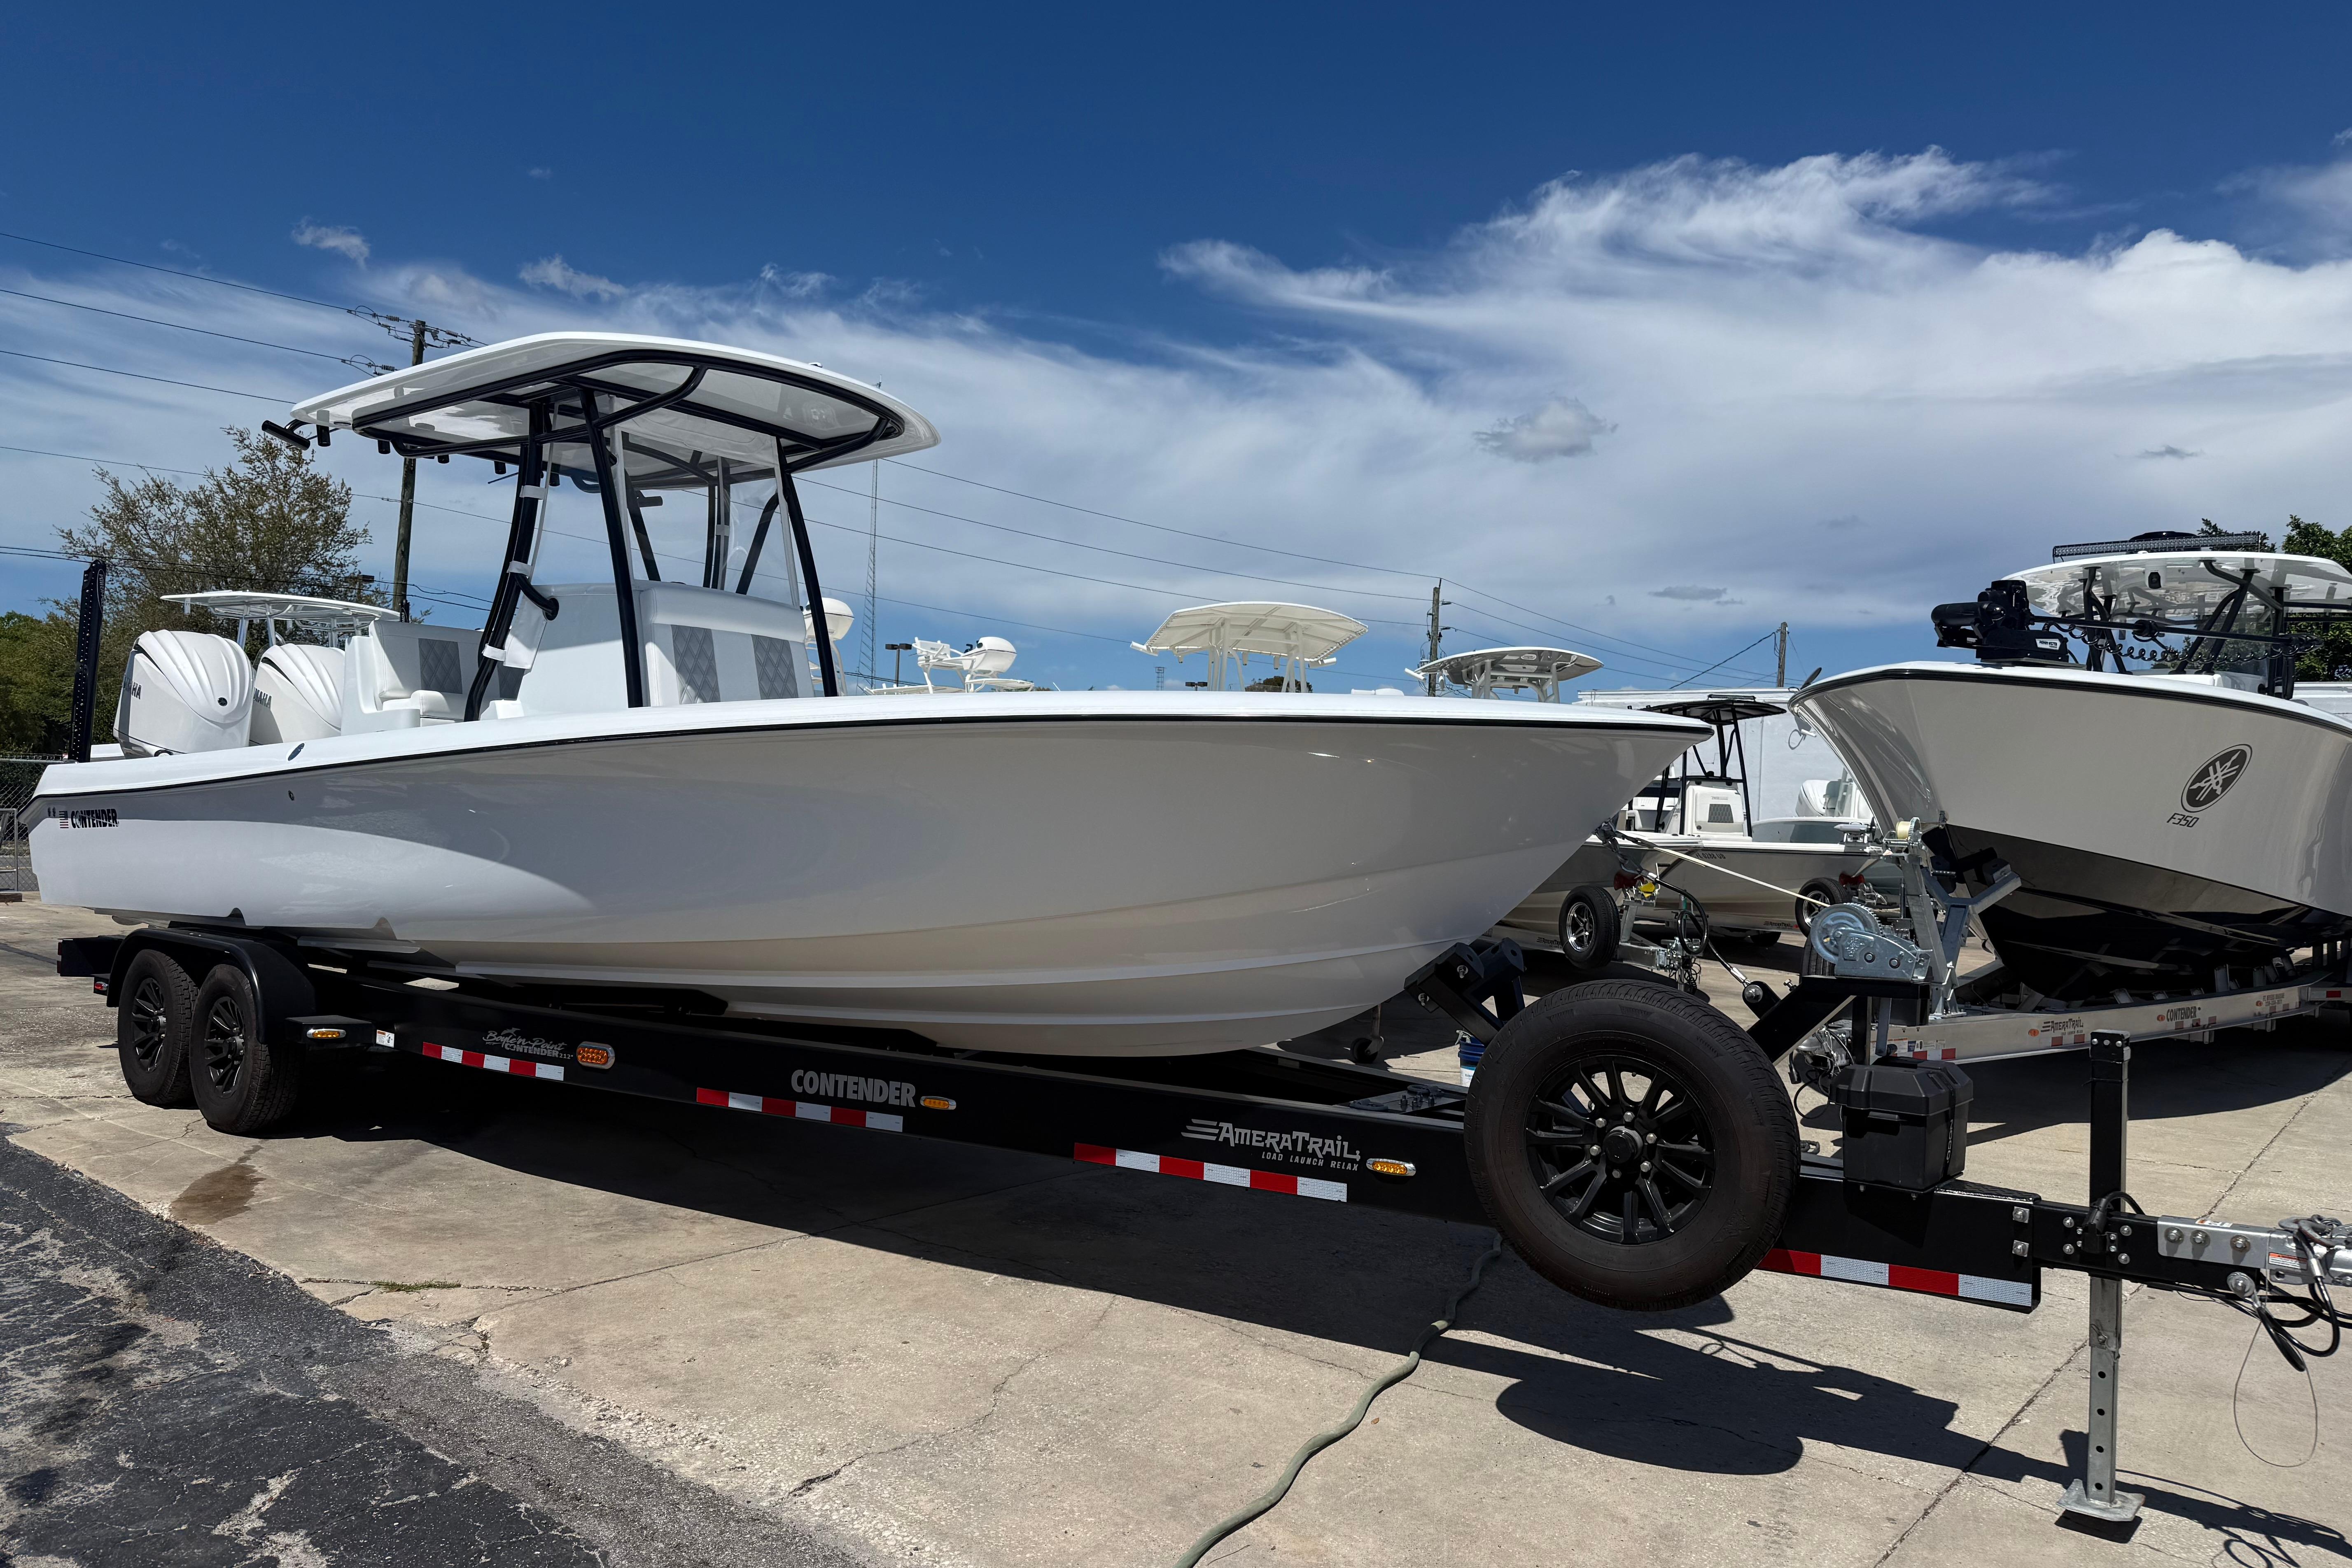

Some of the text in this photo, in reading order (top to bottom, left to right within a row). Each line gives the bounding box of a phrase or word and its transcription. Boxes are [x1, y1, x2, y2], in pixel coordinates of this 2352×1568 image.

[71, 808, 119, 828] CONTENDER
[2166, 812, 2199, 828] F350
[2167, 1006, 2197, 1022] CONTENDER
[504, 1043, 559, 1058] CONTENDER
[531, 1038, 567, 1050] Point
[791, 1069, 916, 1107] CONTENDER
[1262, 1151, 1358, 1171] LOAD LAUNCH RELAX
